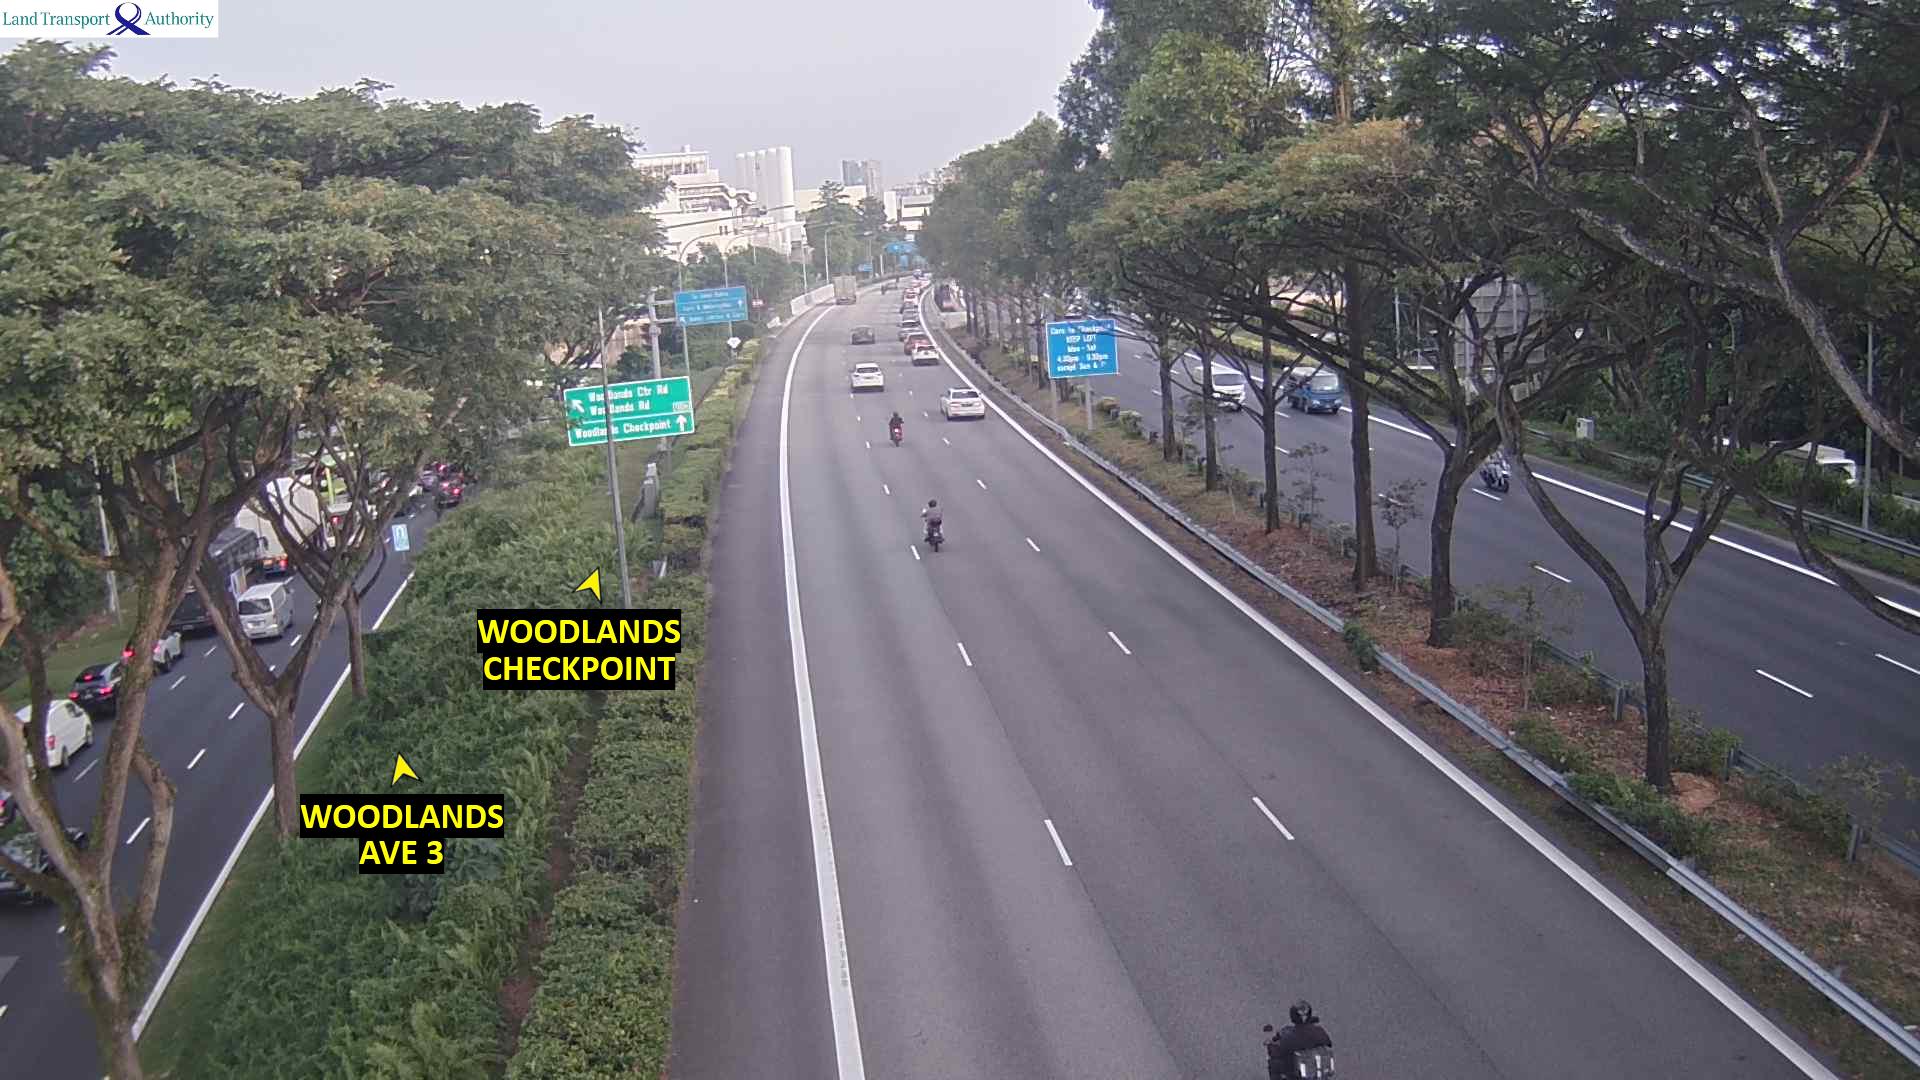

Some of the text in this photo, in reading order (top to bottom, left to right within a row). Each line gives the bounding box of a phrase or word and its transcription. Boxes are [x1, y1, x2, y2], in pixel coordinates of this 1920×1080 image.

[588, 388, 633, 402] Woolands
[656, 385, 668, 395] Rd
[590, 401, 650, 416] Woolands Rd
[623, 420, 672, 434] Checkpoint
